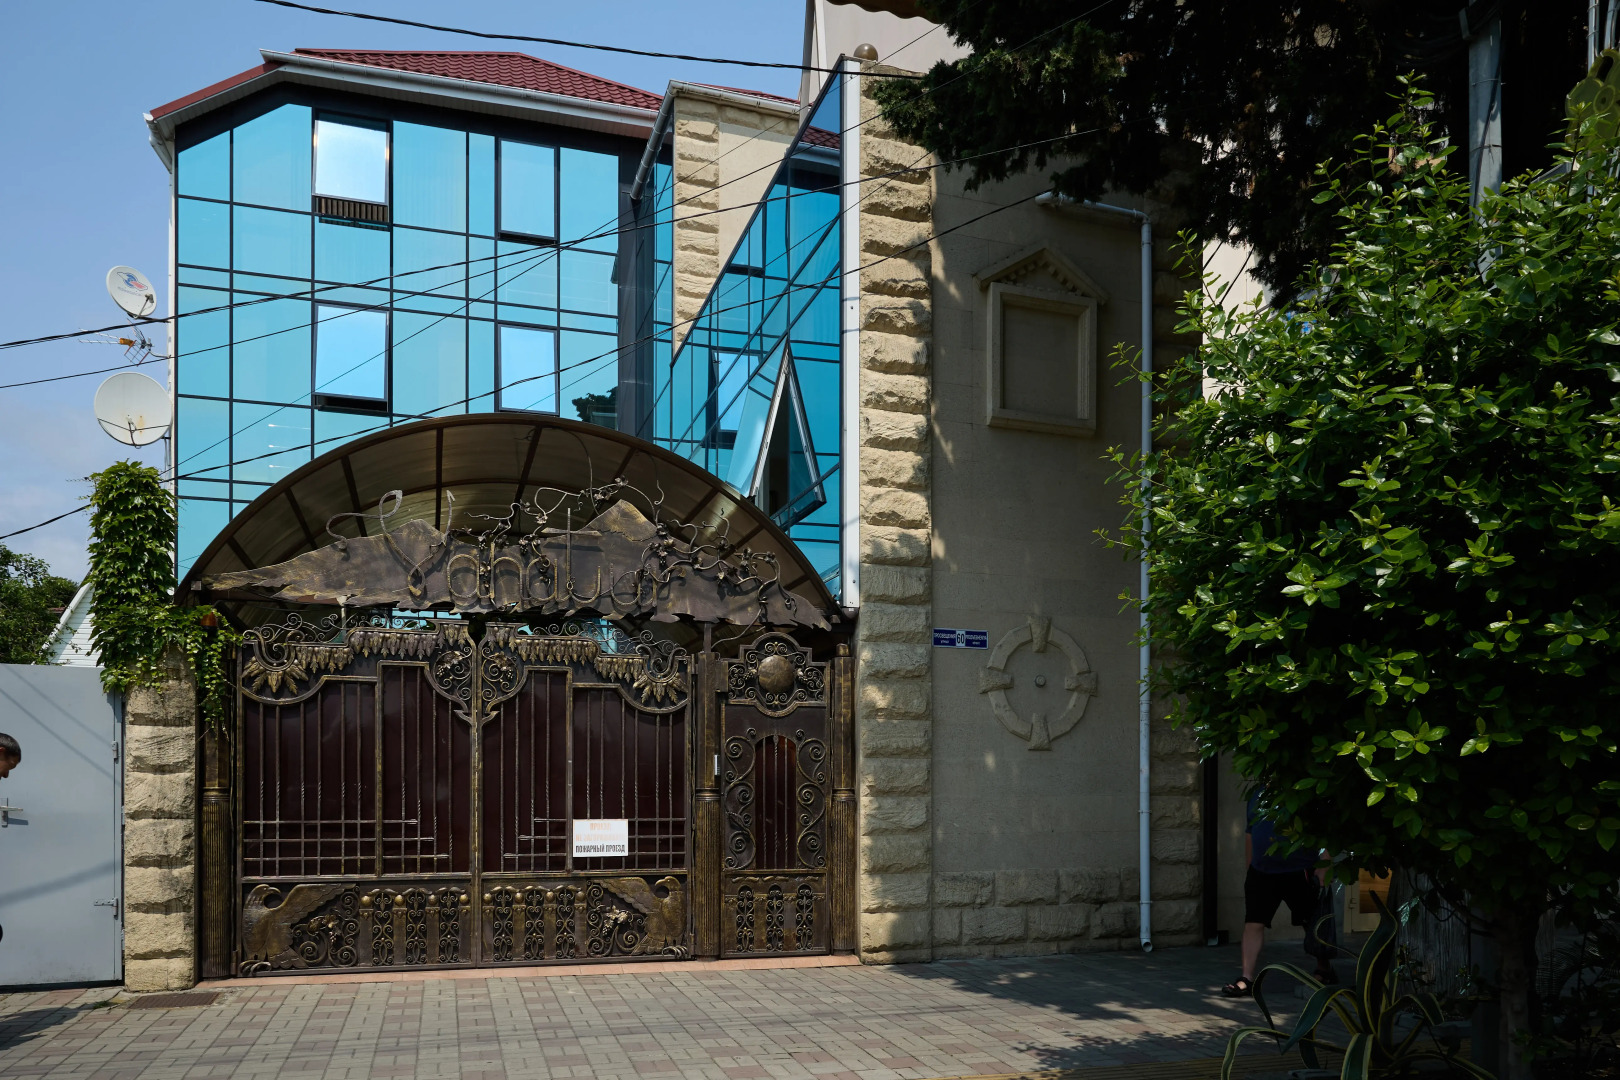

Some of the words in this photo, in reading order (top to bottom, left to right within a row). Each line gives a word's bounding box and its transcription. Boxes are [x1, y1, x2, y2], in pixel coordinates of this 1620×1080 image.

[957, 634, 964, 644] 60
[576, 844, 605, 853] ПОЖАРНЫЙ
[605, 845, 625, 853] ПРОЕЗД
